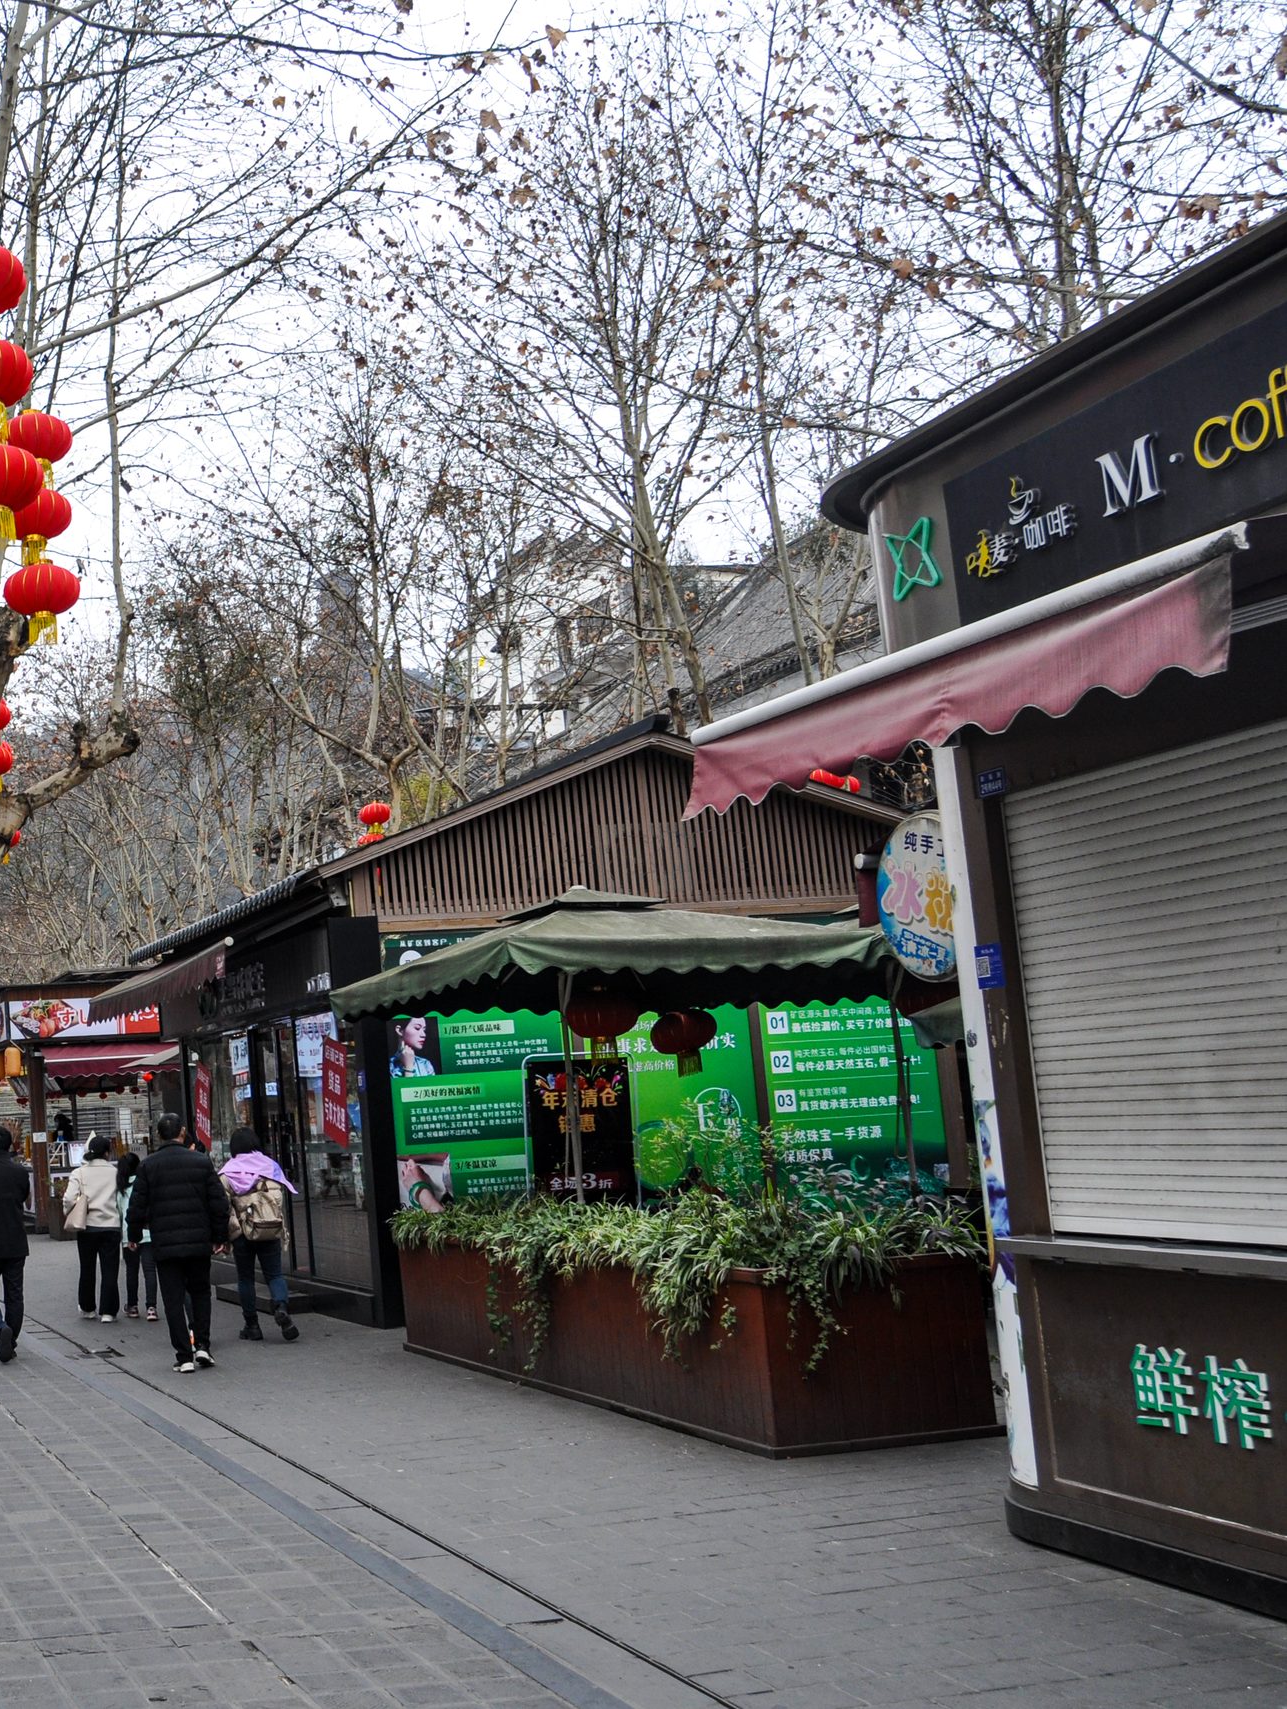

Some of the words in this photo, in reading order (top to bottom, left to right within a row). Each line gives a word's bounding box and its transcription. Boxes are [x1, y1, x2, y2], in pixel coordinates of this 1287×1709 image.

[770, 1016, 785, 1030] 01
[773, 1056, 789, 1068] 02
[777, 1094, 794, 1107] 03
[780, 1125, 882, 1144] 天然珠宝一手货源
[784, 1147, 834, 1164] 保质保真
[1129, 1343, 1273, 1450] 鲜榨
